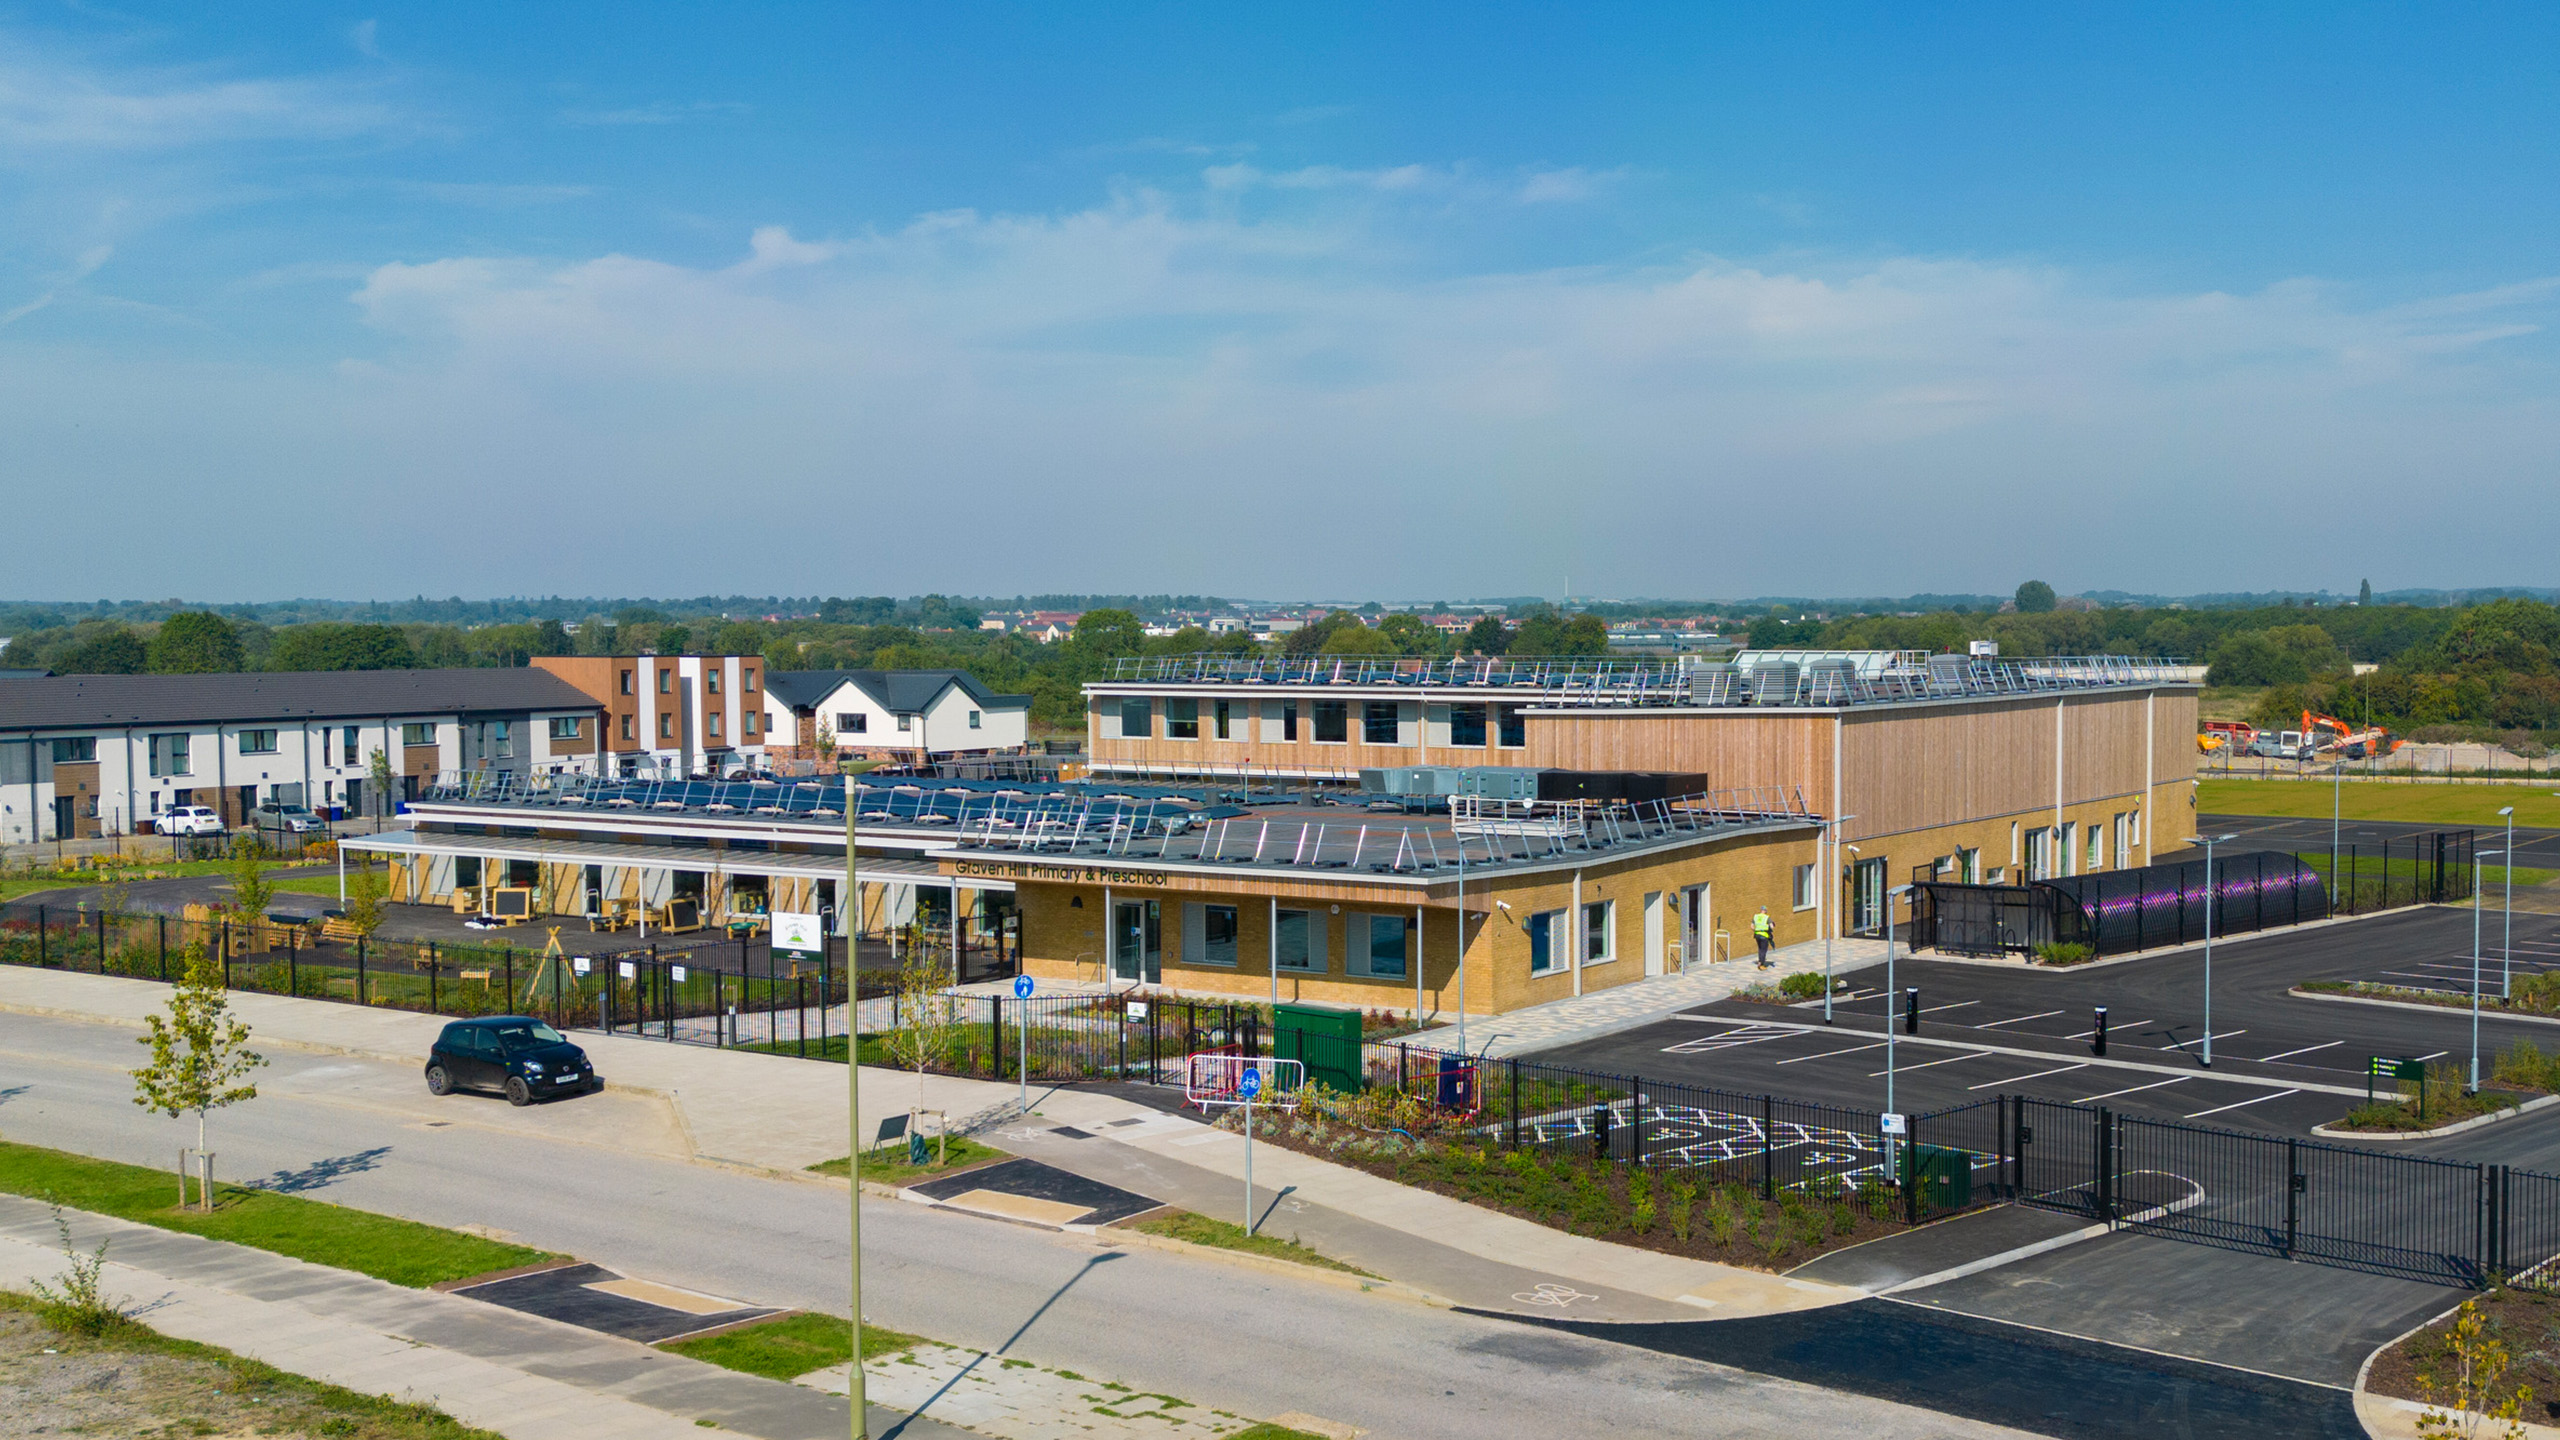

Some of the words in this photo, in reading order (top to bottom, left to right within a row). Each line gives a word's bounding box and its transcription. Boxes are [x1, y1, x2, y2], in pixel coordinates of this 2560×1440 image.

[956, 859, 1004, 876] Graven
[1008, 862, 1027, 877] Hill
[1032, 863, 1081, 884] Primary
[1085, 866, 1095, 881] &
[1100, 867, 1167, 886] Preschool
